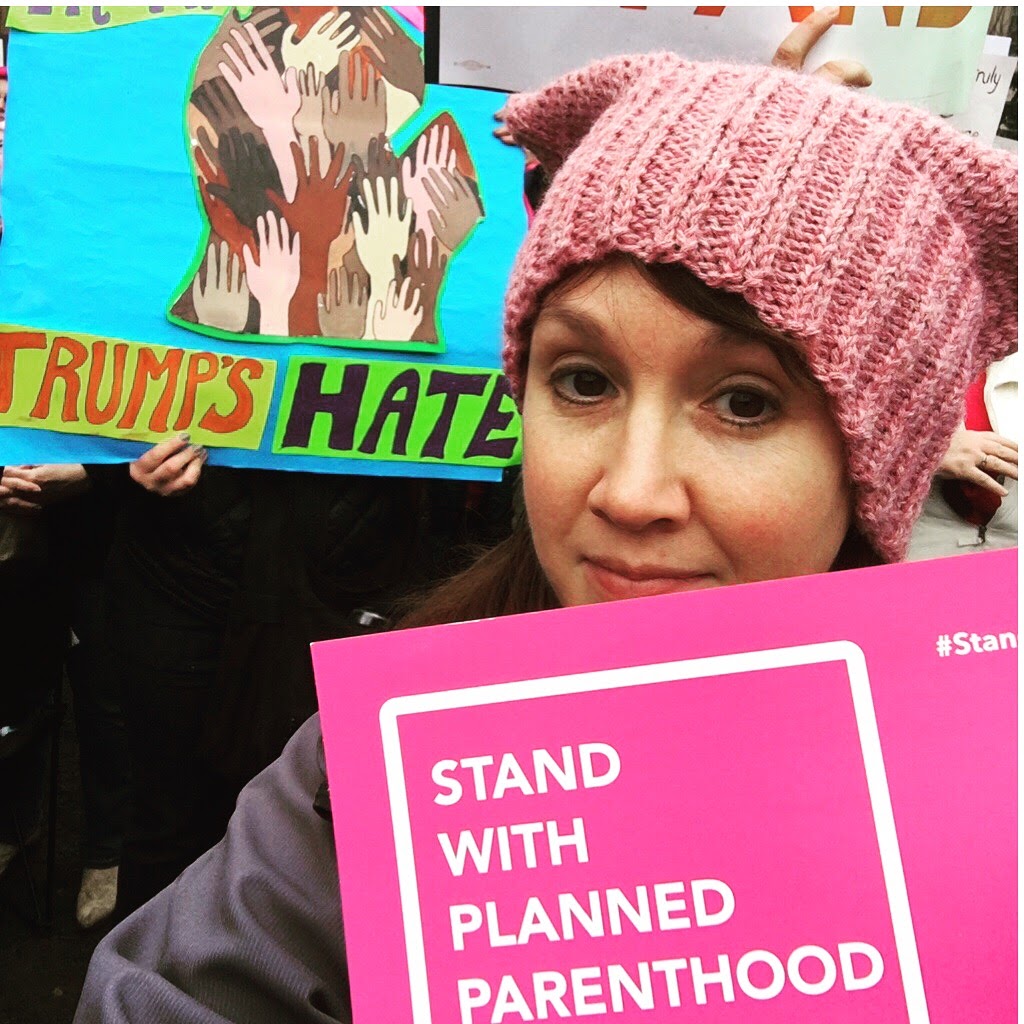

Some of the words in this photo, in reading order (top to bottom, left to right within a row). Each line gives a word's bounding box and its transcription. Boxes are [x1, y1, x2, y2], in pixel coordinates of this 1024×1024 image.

[975, 65, 1001, 94] ruly
[0, 331, 264, 435] TRUMP'S
[281, 362, 521, 460] HATE
[936, 631, 1018, 658] #Stan
[431, 742, 622, 807] STAND
[437, 817, 590, 877] WITH
[449, 878, 736, 952] PLANNED
[457, 942, 885, 1024] PARENTHOOD
